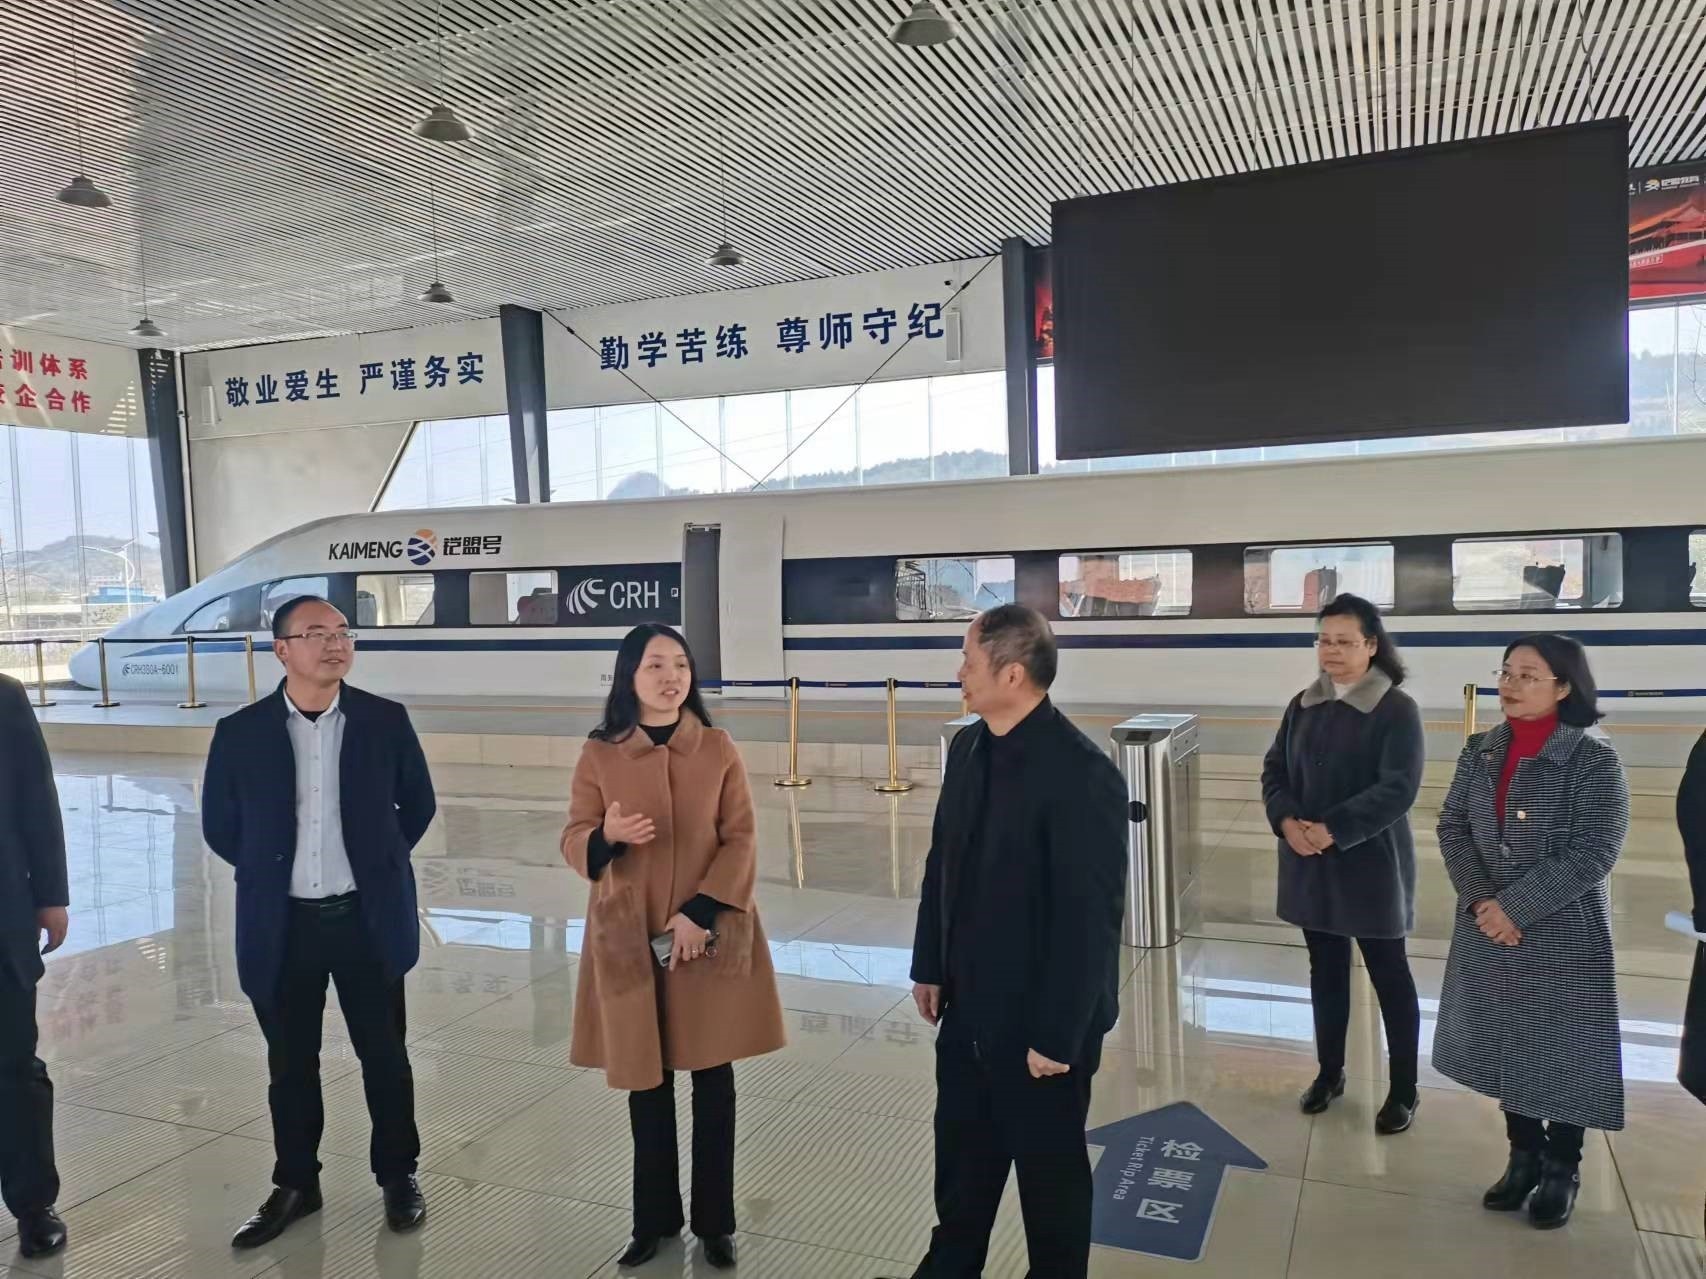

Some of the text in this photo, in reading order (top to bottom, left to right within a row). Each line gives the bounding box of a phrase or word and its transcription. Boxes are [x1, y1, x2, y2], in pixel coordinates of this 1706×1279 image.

[599, 302, 944, 370] 勤学苦练 尊师守纪
[0, 348, 88, 380] 训体系
[225, 352, 484, 408] 敬业爱生 严谨务实
[0, 383, 92, 414] 企合作
[328, 541, 404, 561] KAIMENG
[609, 580, 660, 609] CRH
[1130, 1136, 1155, 1161] Ticket
[1113, 1177, 1135, 1200] Area
[1135, 1139, 1205, 1224] 检票区
